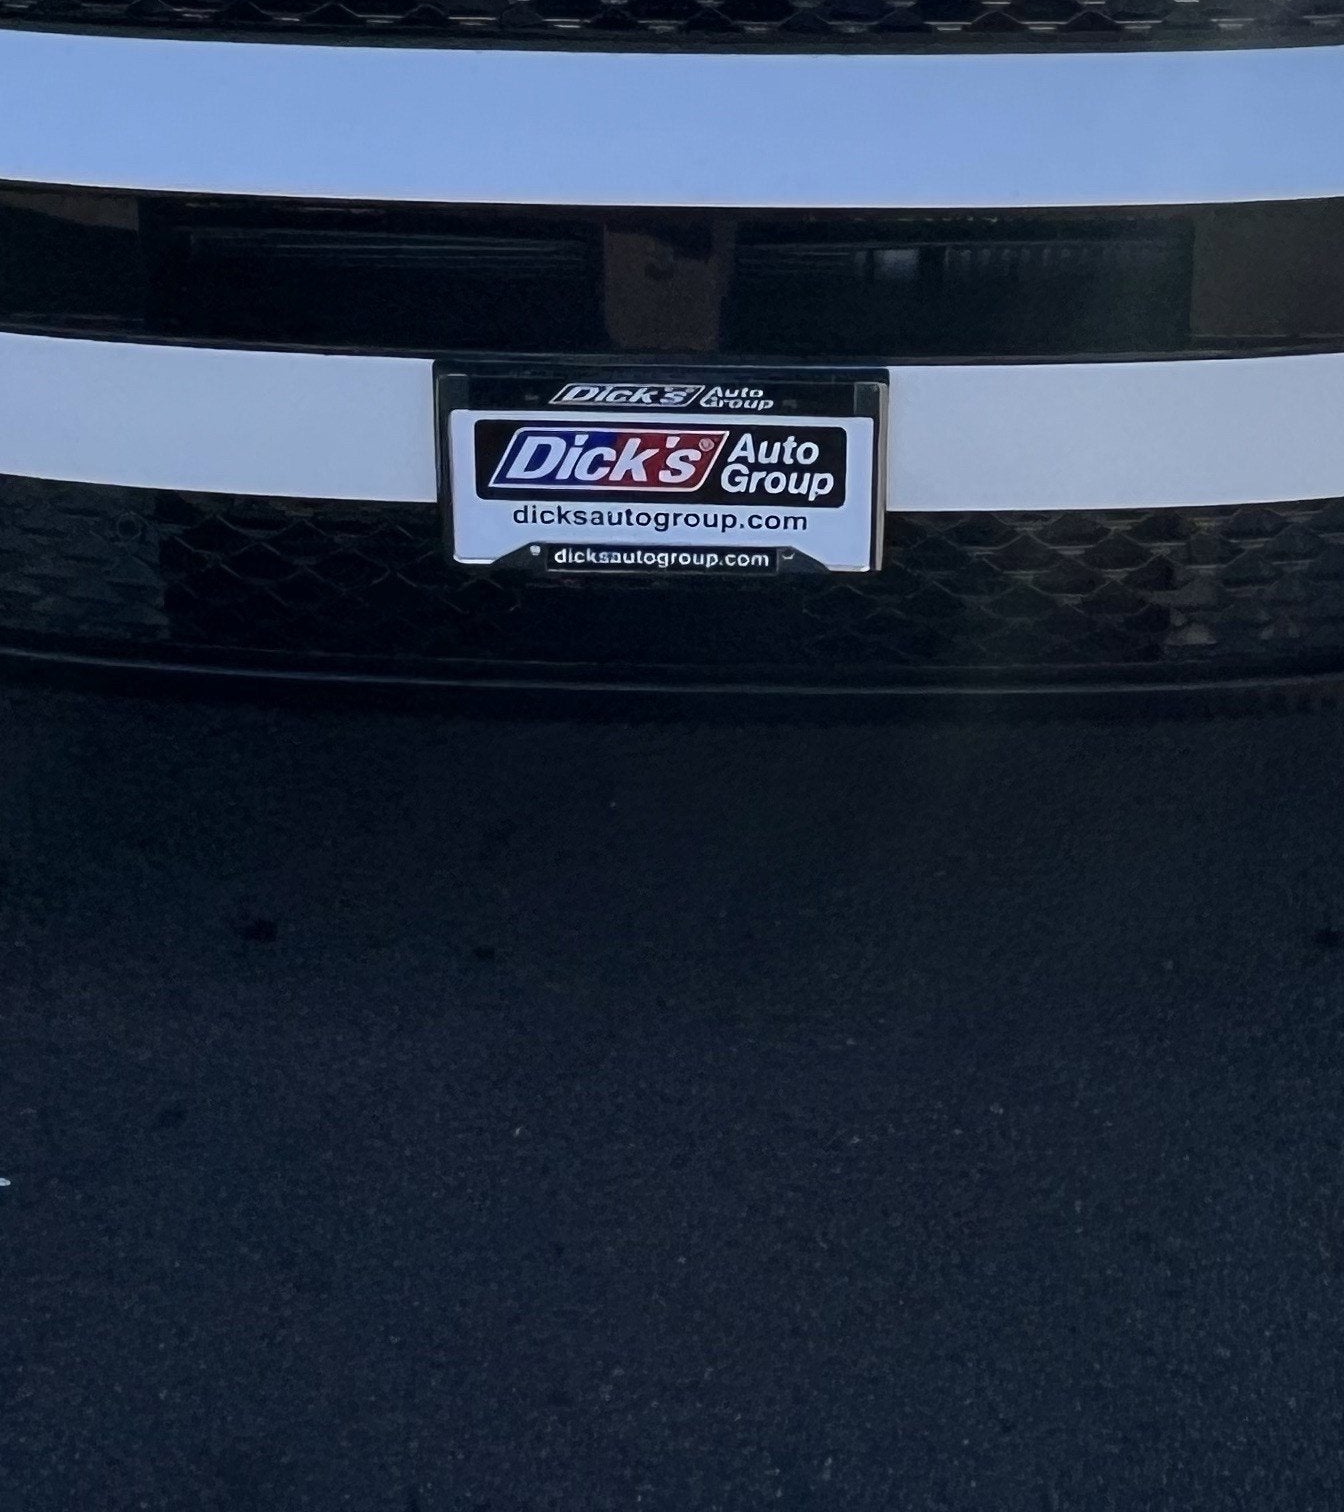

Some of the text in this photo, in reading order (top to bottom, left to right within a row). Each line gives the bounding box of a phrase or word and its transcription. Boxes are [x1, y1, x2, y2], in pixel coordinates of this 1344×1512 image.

[699, 398, 774, 411] Group
[705, 386, 764, 398] Auto
[505, 433, 701, 483] Dick's
[727, 432, 819, 465] Auto
[720, 463, 834, 501] Group
[513, 505, 808, 532] dicksautogroup.com
[554, 548, 770, 568] dicksautogroup.com
